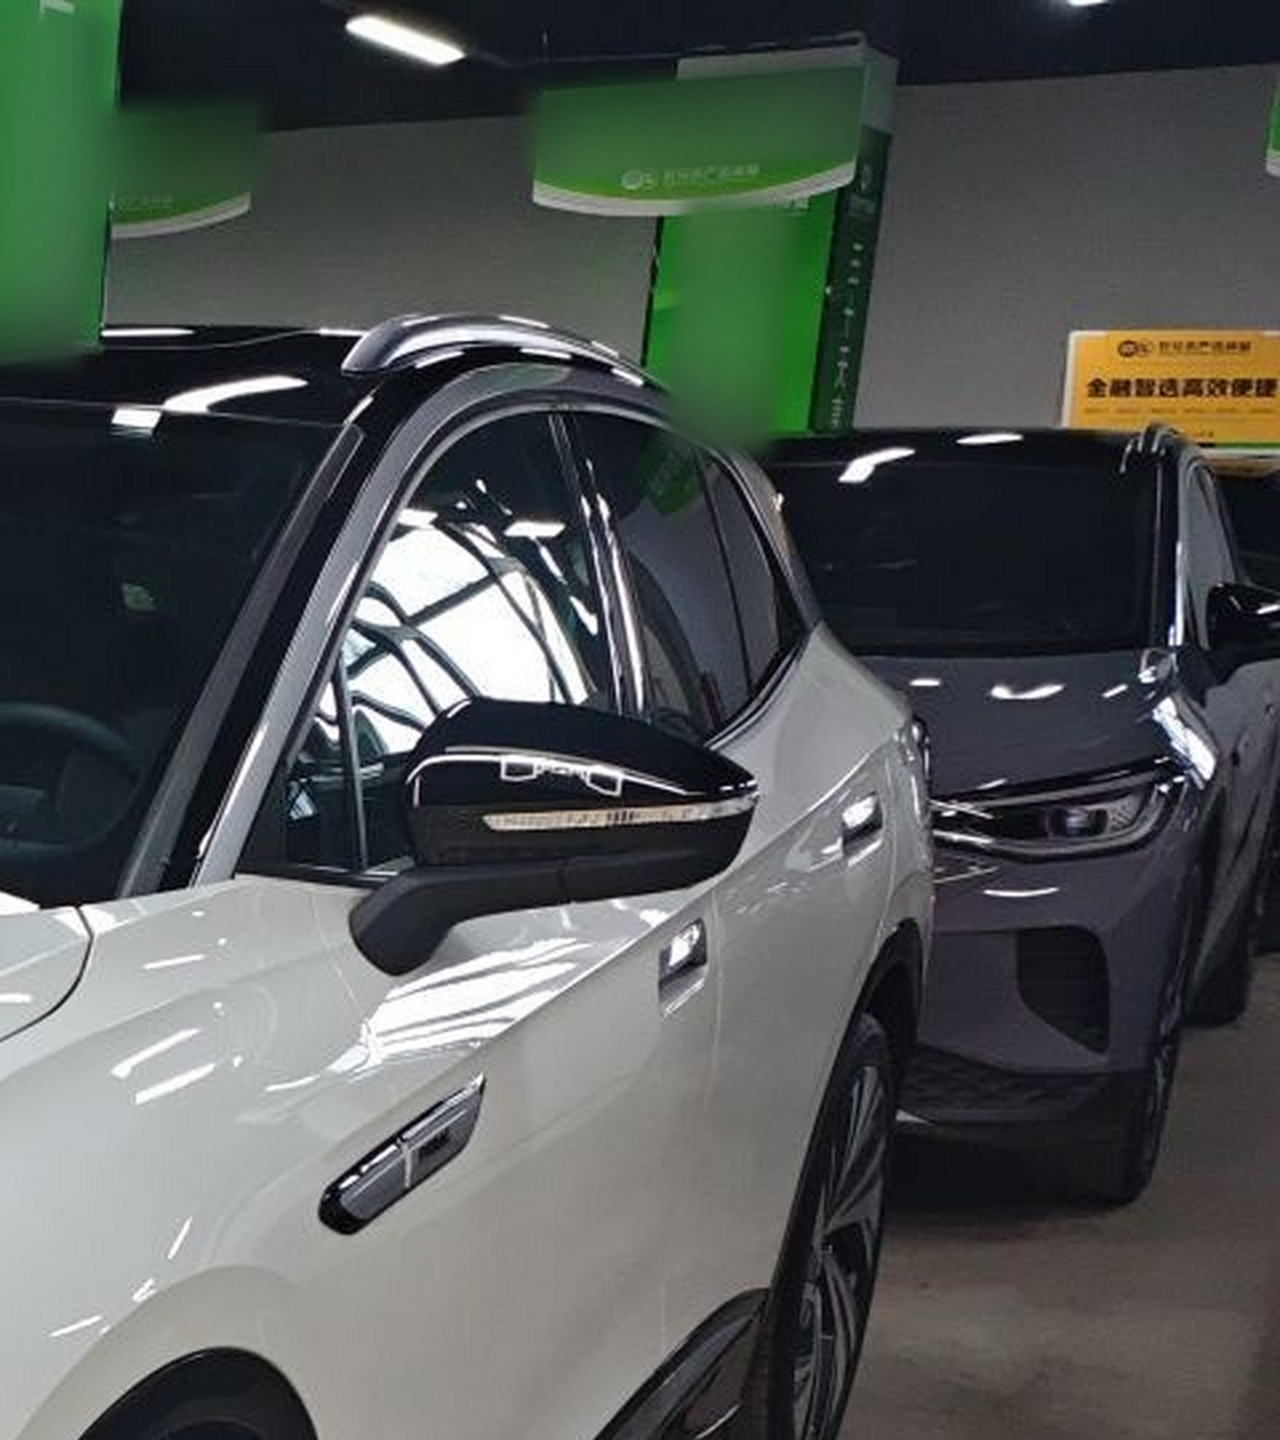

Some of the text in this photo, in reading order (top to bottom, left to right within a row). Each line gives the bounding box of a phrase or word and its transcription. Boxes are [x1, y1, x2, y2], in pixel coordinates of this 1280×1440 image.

[1087, 377, 1277, 399] 金融智选高效便捷
